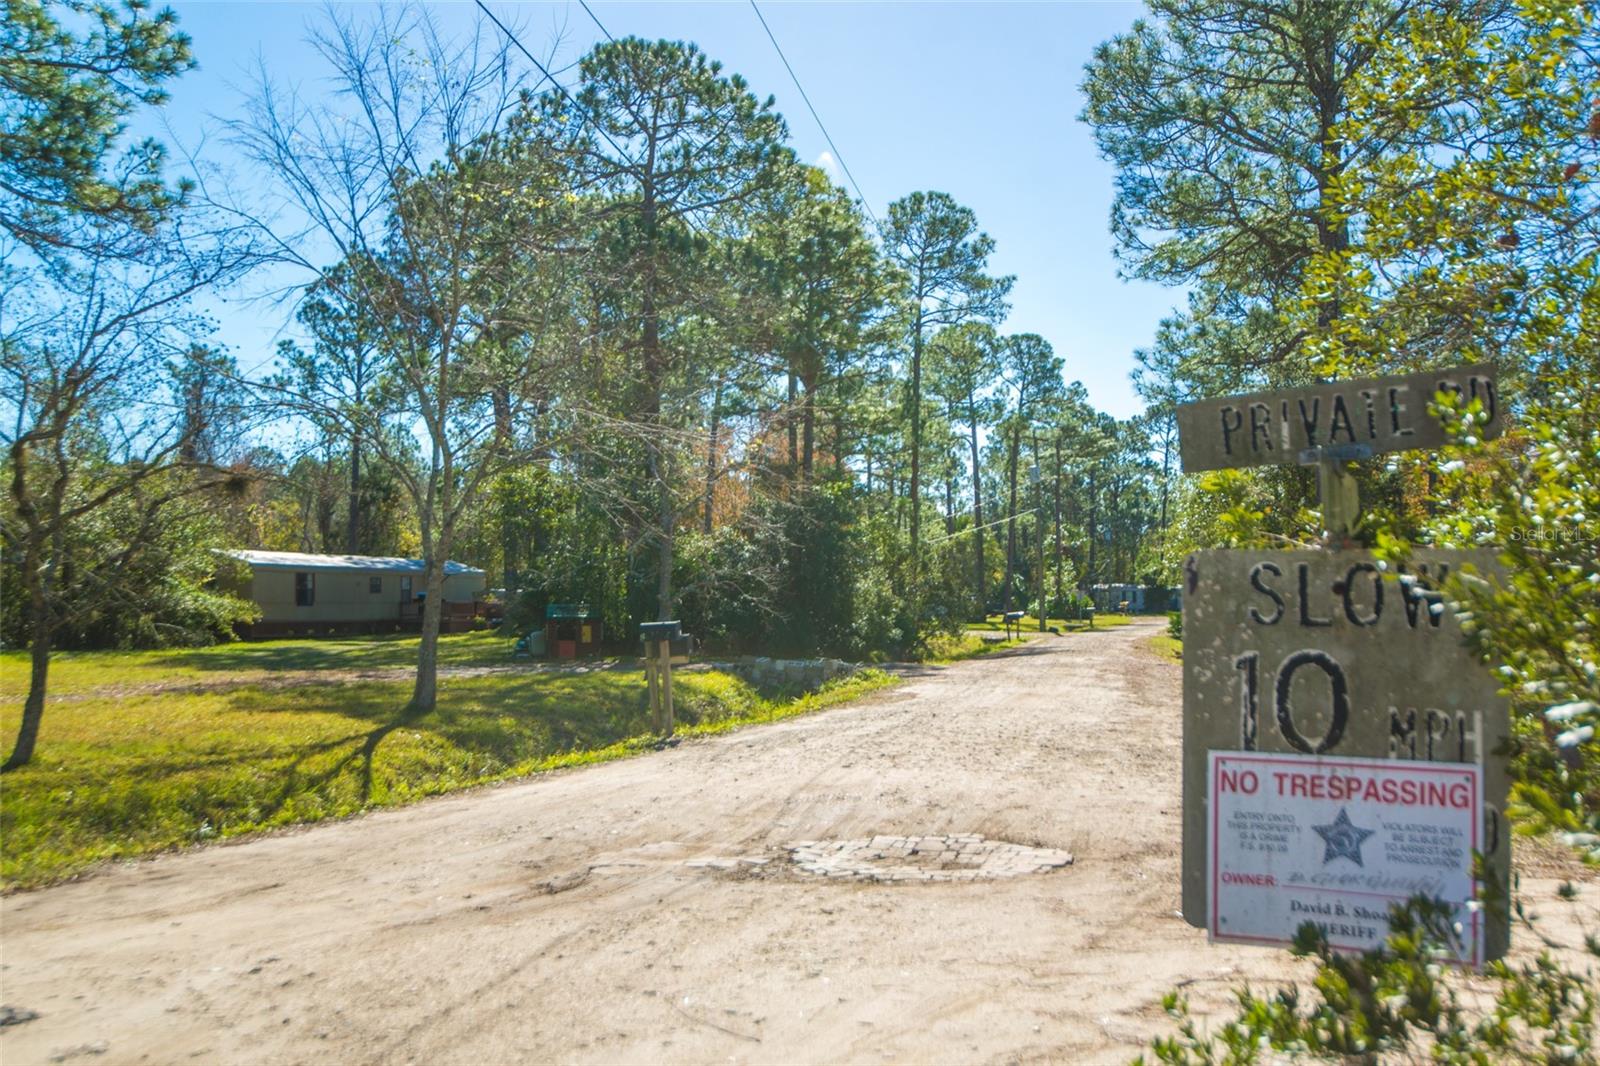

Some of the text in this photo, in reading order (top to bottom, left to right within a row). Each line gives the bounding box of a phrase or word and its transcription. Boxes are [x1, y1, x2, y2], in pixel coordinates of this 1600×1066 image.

[1220, 384, 1416, 456] PRIVATE
[1250, 561, 1450, 629] SLOW
[1236, 649, 1484, 763] 10 MPH
[1220, 769, 1470, 810] NO TRESPASSING
[1233, 810, 1296, 823] ENTRY ONTO
[1250, 821, 1302, 834] PROPERTY
[1382, 821, 1464, 837] VIOLATORS WILL
[1407, 833, 1454, 847] SUBJECT
[1290, 900, 1331, 916] David
[1335, 903, 1349, 917] B.
